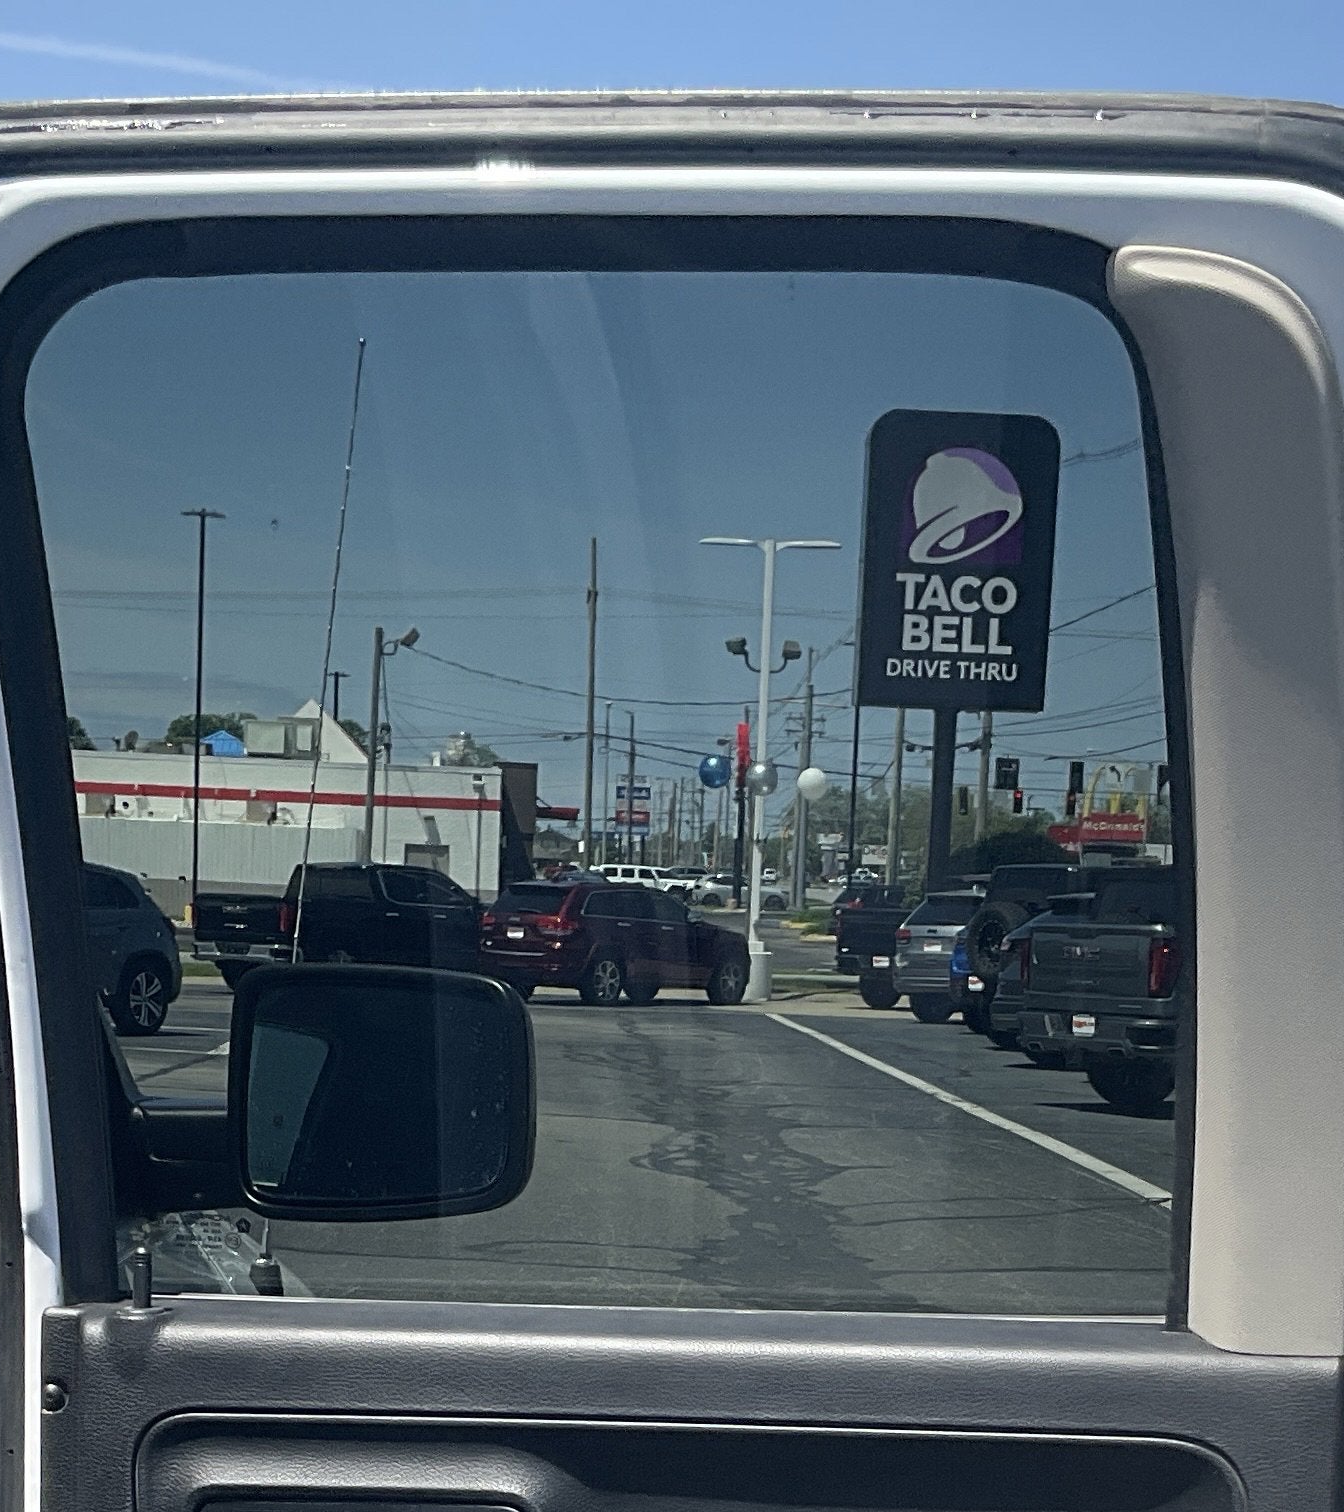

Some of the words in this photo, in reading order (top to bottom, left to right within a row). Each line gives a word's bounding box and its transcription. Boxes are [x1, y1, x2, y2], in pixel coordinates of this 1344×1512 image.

[895, 572, 1018, 615] TACO
[901, 614, 1013, 655] BELL
[885, 657, 951, 679] DRIVE
[956, 660, 1018, 682] THRU
